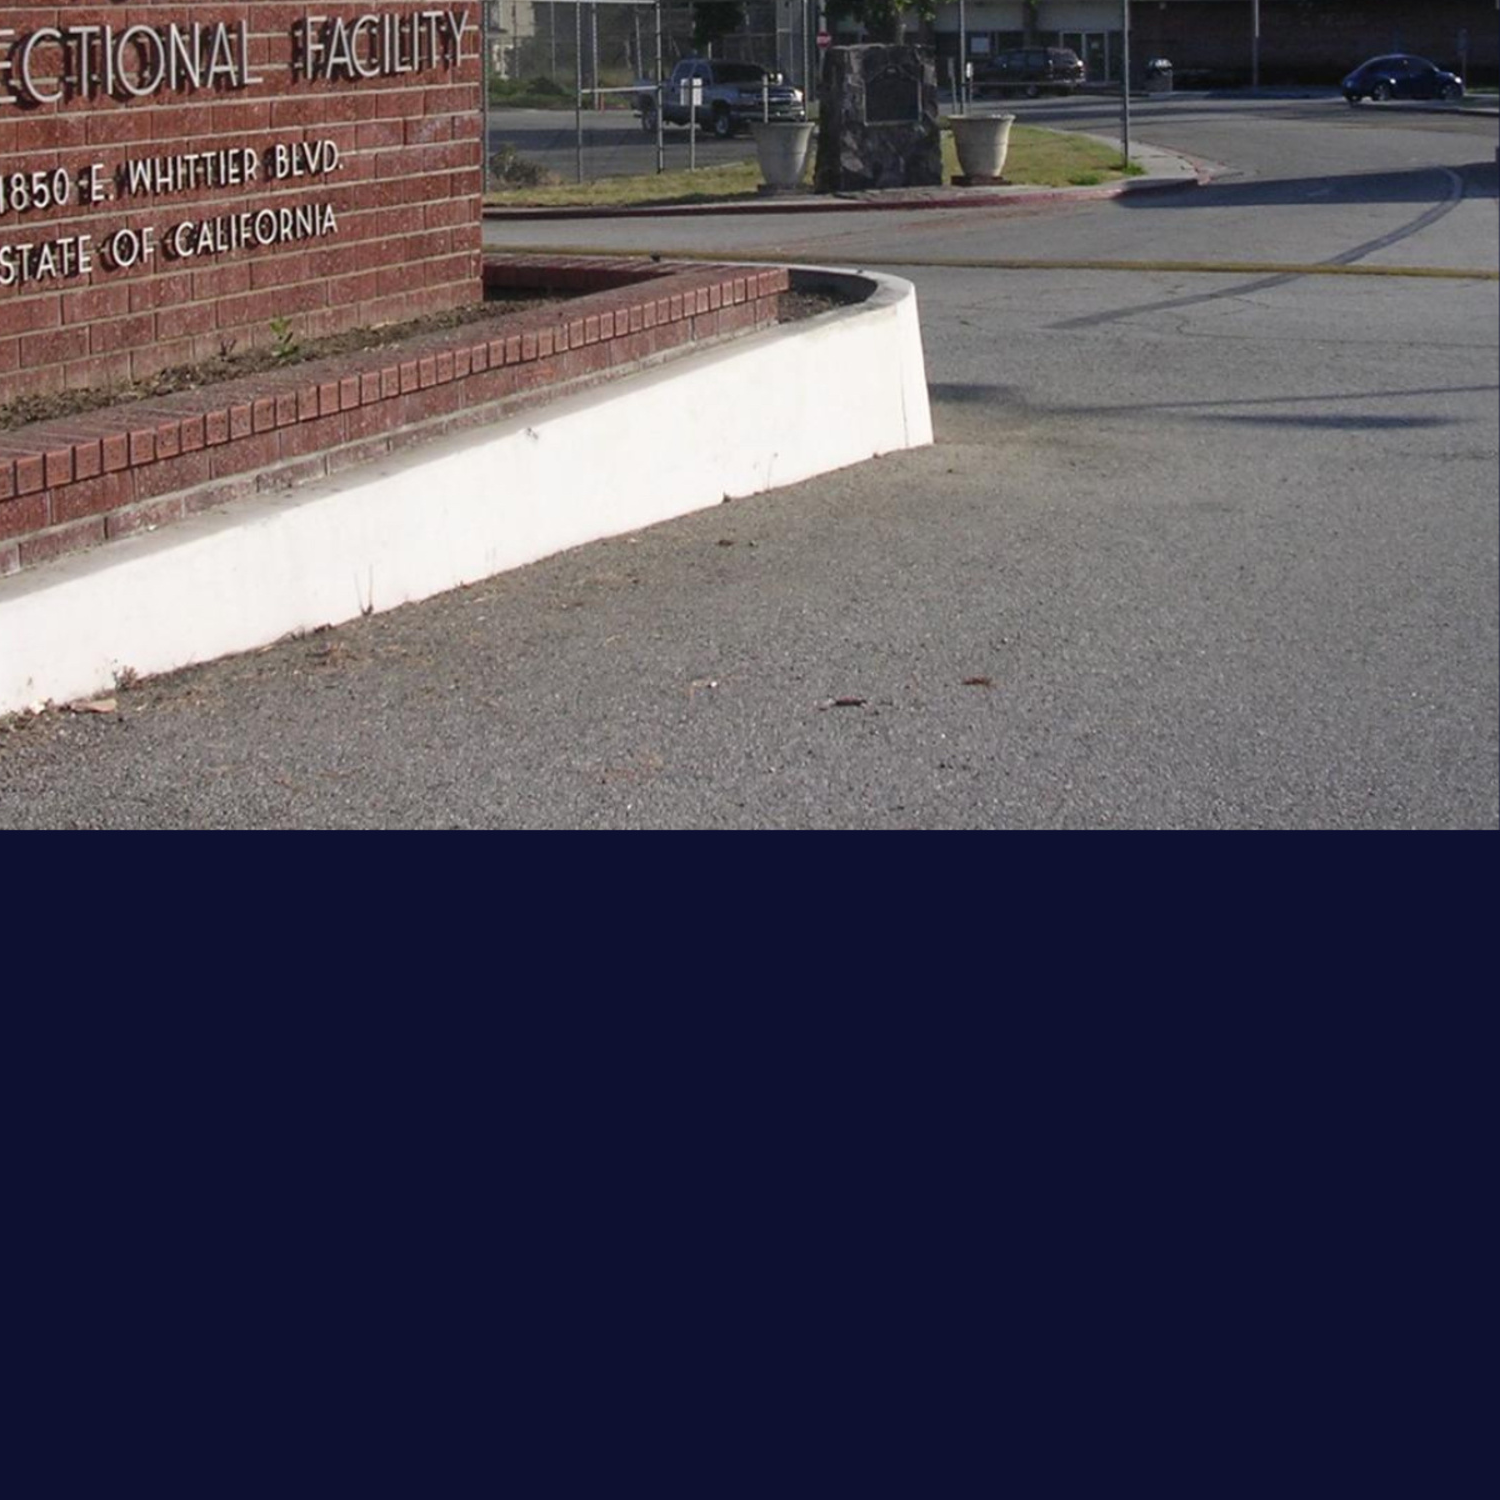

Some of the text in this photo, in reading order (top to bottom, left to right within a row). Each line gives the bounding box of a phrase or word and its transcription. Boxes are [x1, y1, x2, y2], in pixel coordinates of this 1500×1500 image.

[306, 10, 469, 80] FACILITY
[90, 164, 114, 200] E.
[128, 148, 257, 195] WHITTIER
[275, 139, 344, 180] BLVD.
[113, 227, 154, 267] OF
[174, 203, 338, 258] CALIFORNIA
